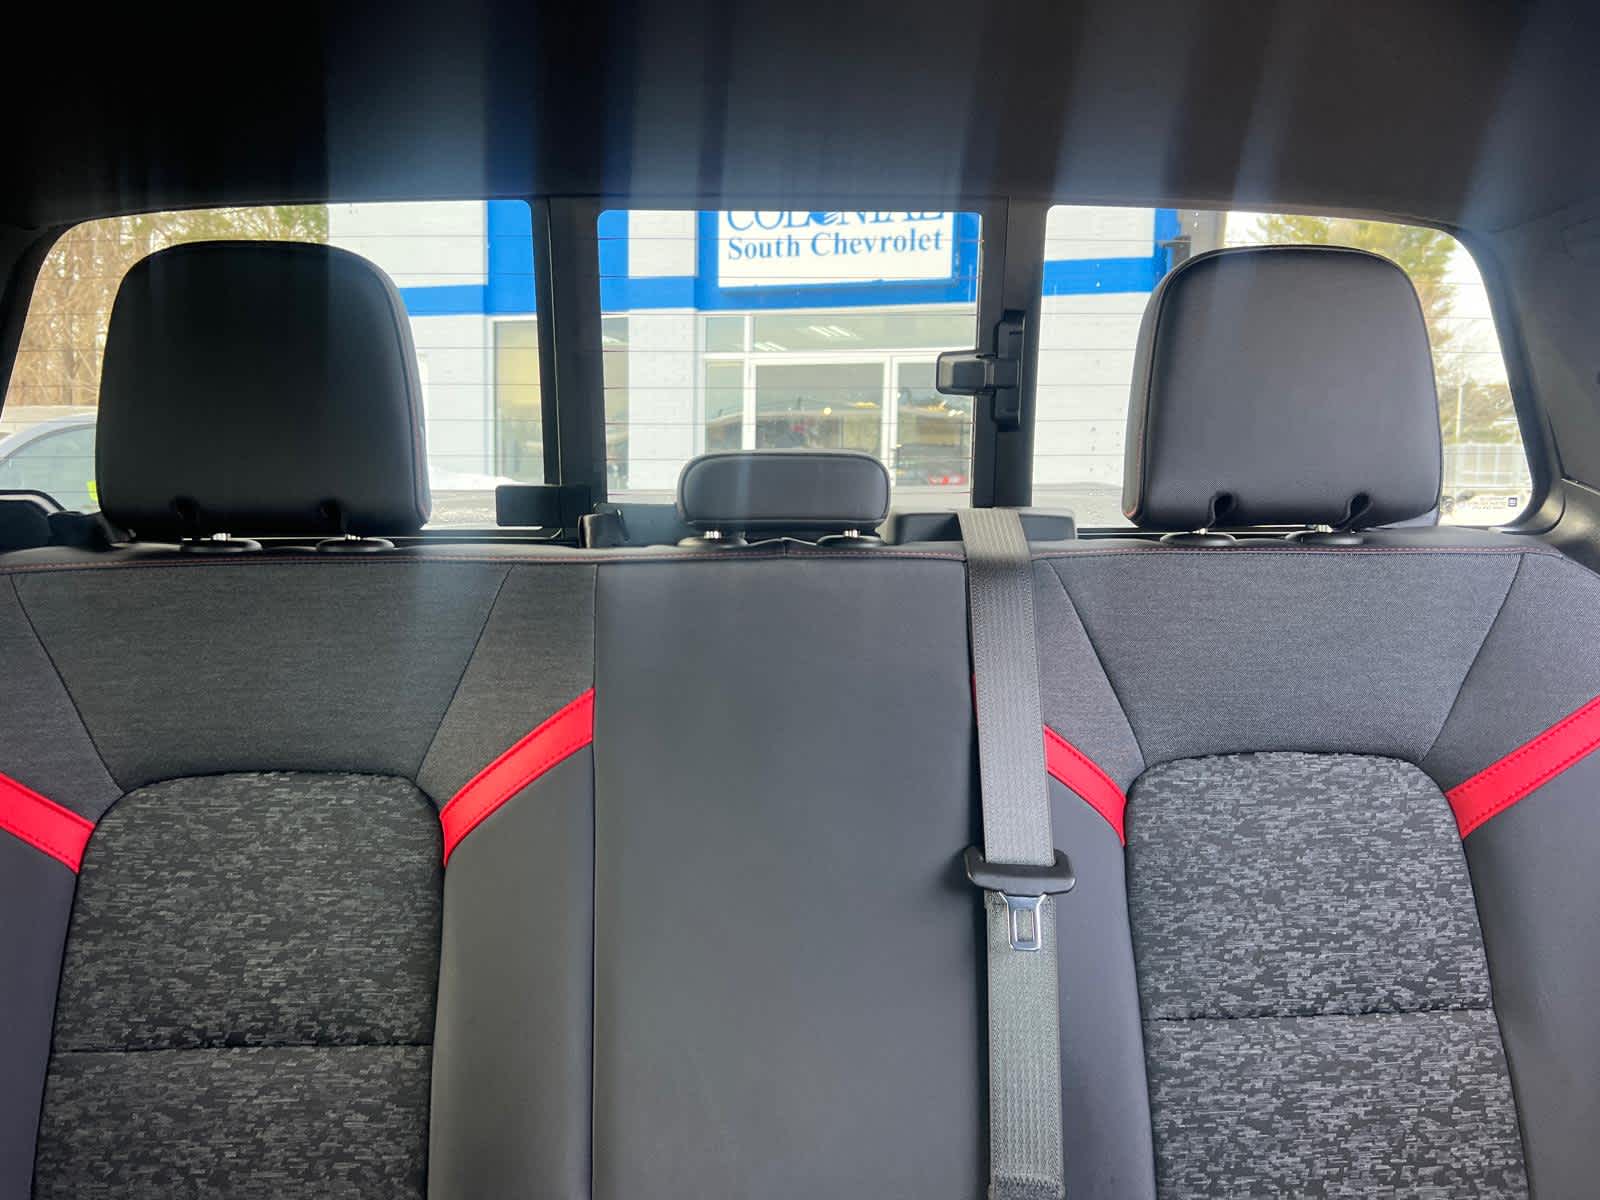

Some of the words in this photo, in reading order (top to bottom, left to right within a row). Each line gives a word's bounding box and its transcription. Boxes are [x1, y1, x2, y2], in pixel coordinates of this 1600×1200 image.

[727, 210, 944, 231] COLO
[728, 234, 800, 260] South
[811, 228, 943, 256] Chevrolet
